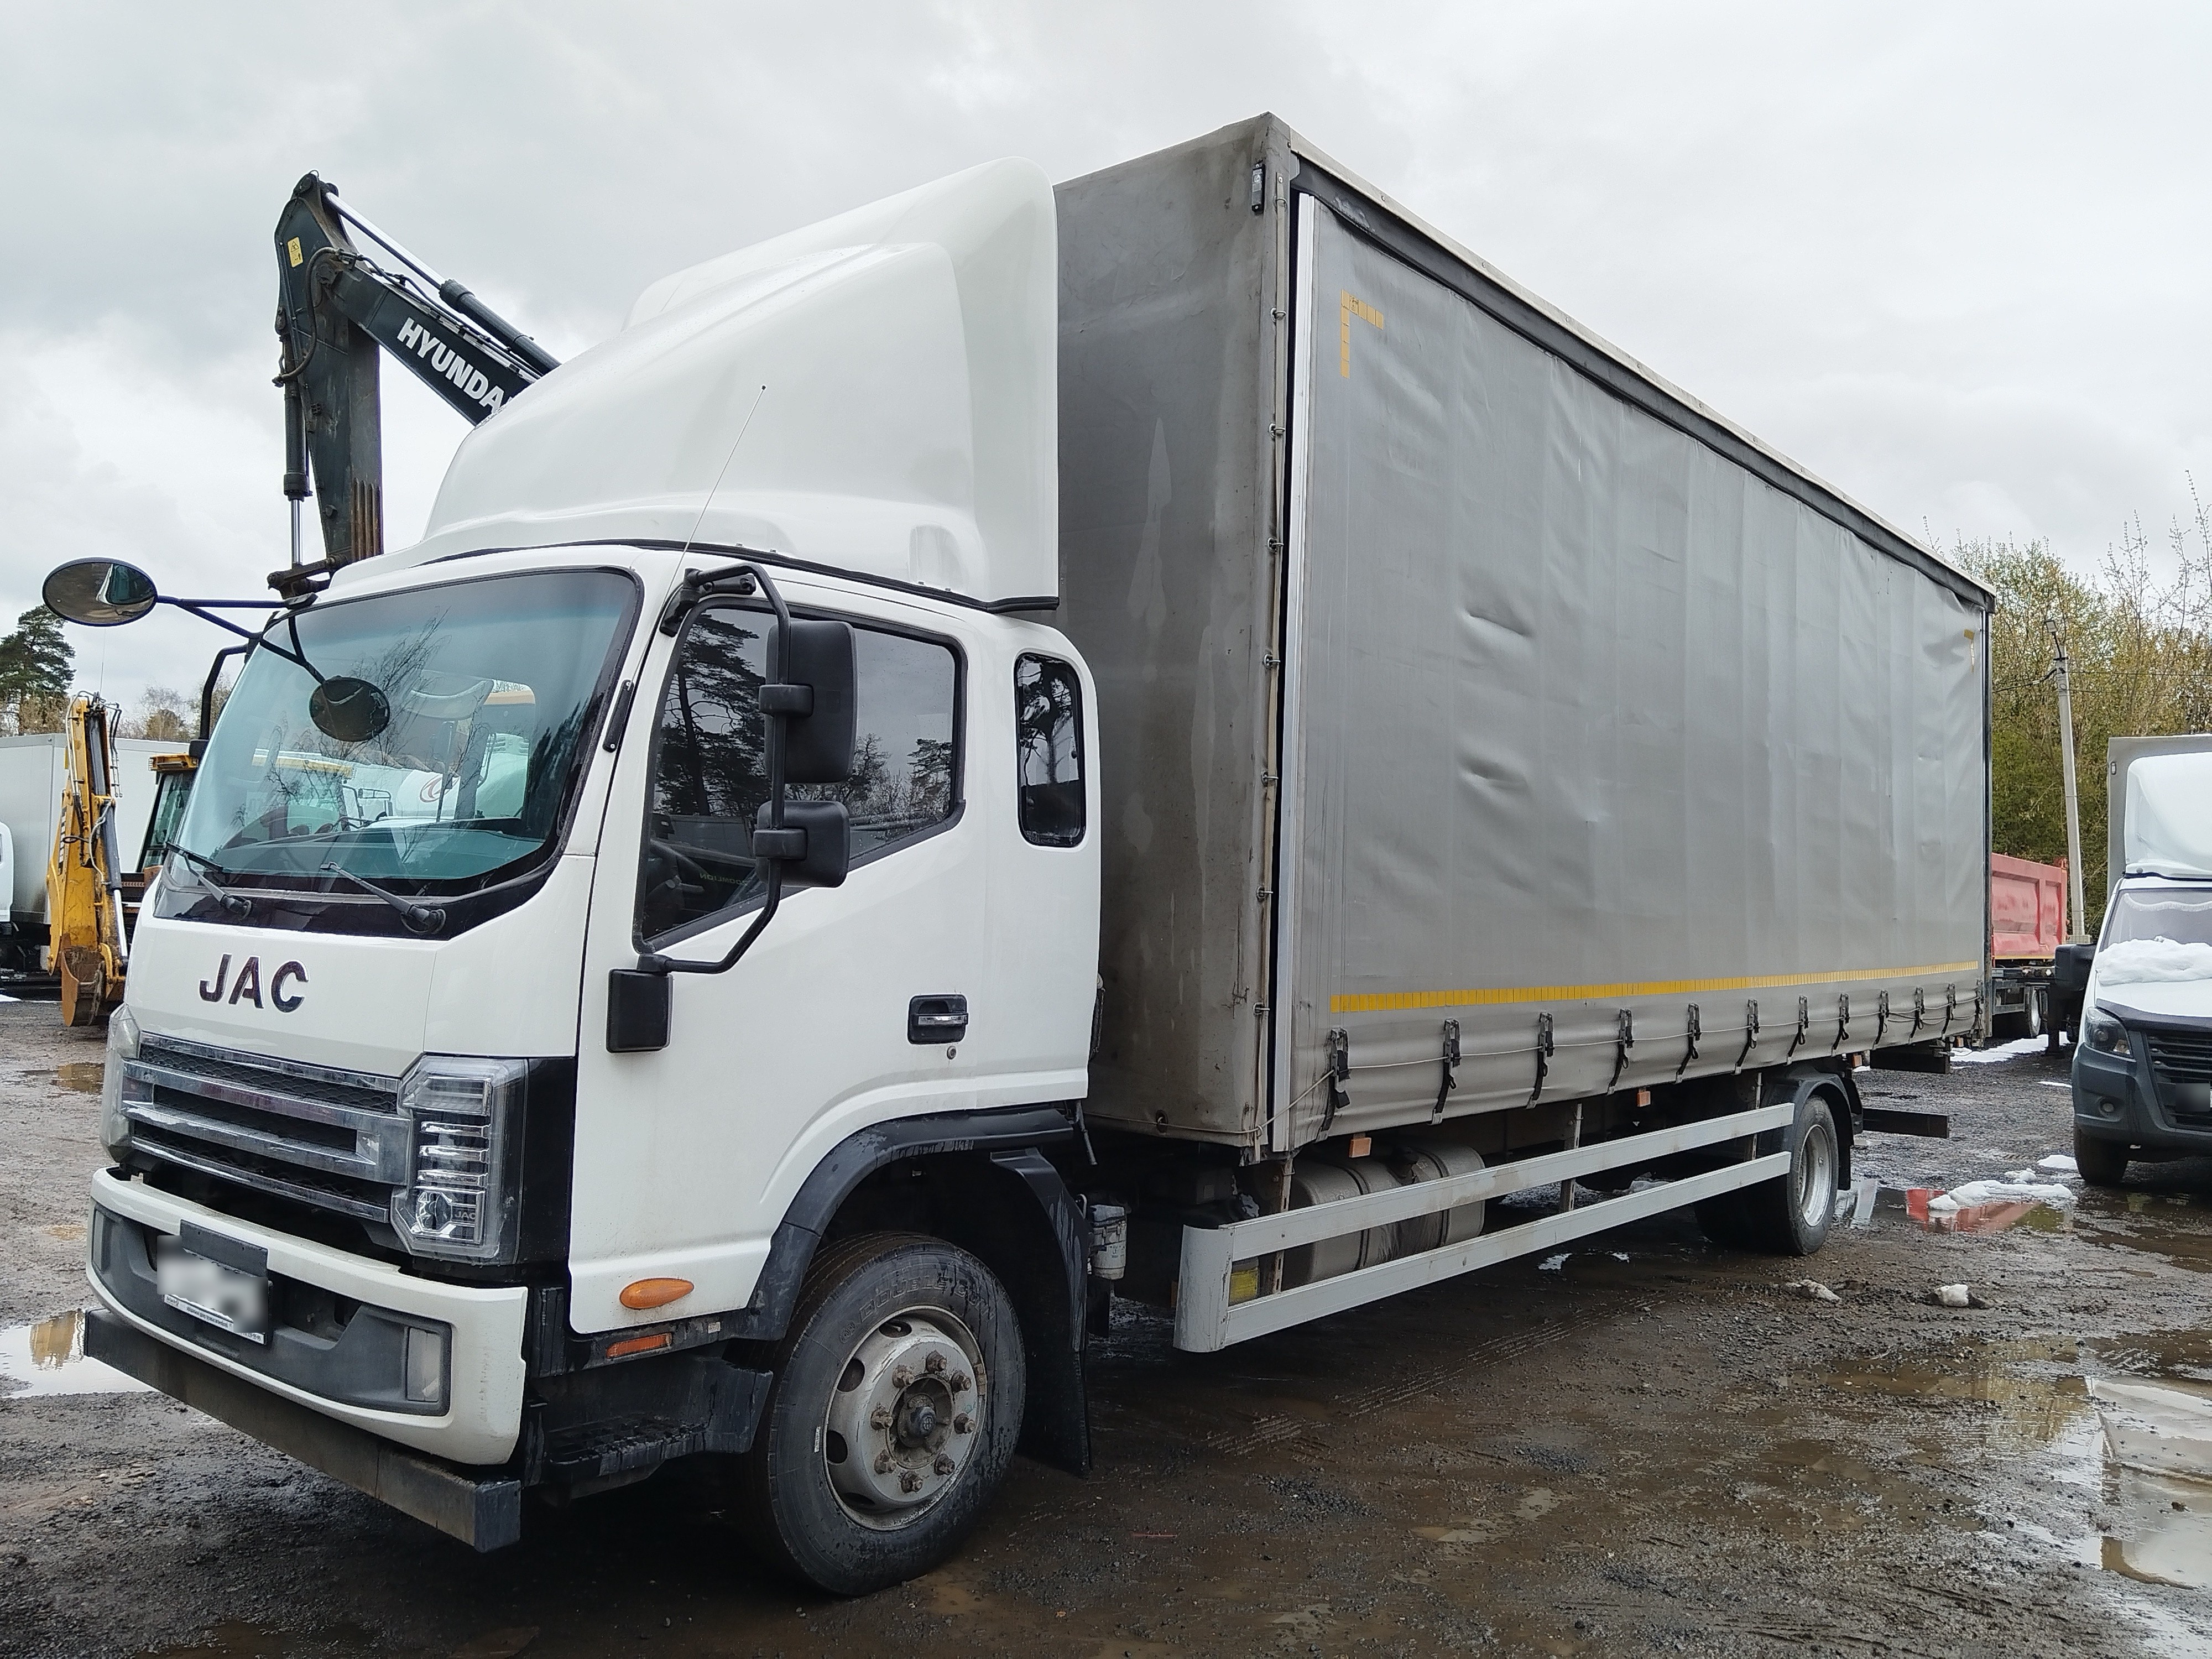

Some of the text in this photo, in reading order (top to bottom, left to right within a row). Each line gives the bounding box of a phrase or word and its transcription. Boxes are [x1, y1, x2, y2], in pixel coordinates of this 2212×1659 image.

[397, 317, 513, 414] HYUNDA
[199, 953, 309, 1013] JAC
[455, 1211, 476, 1220] JAC
